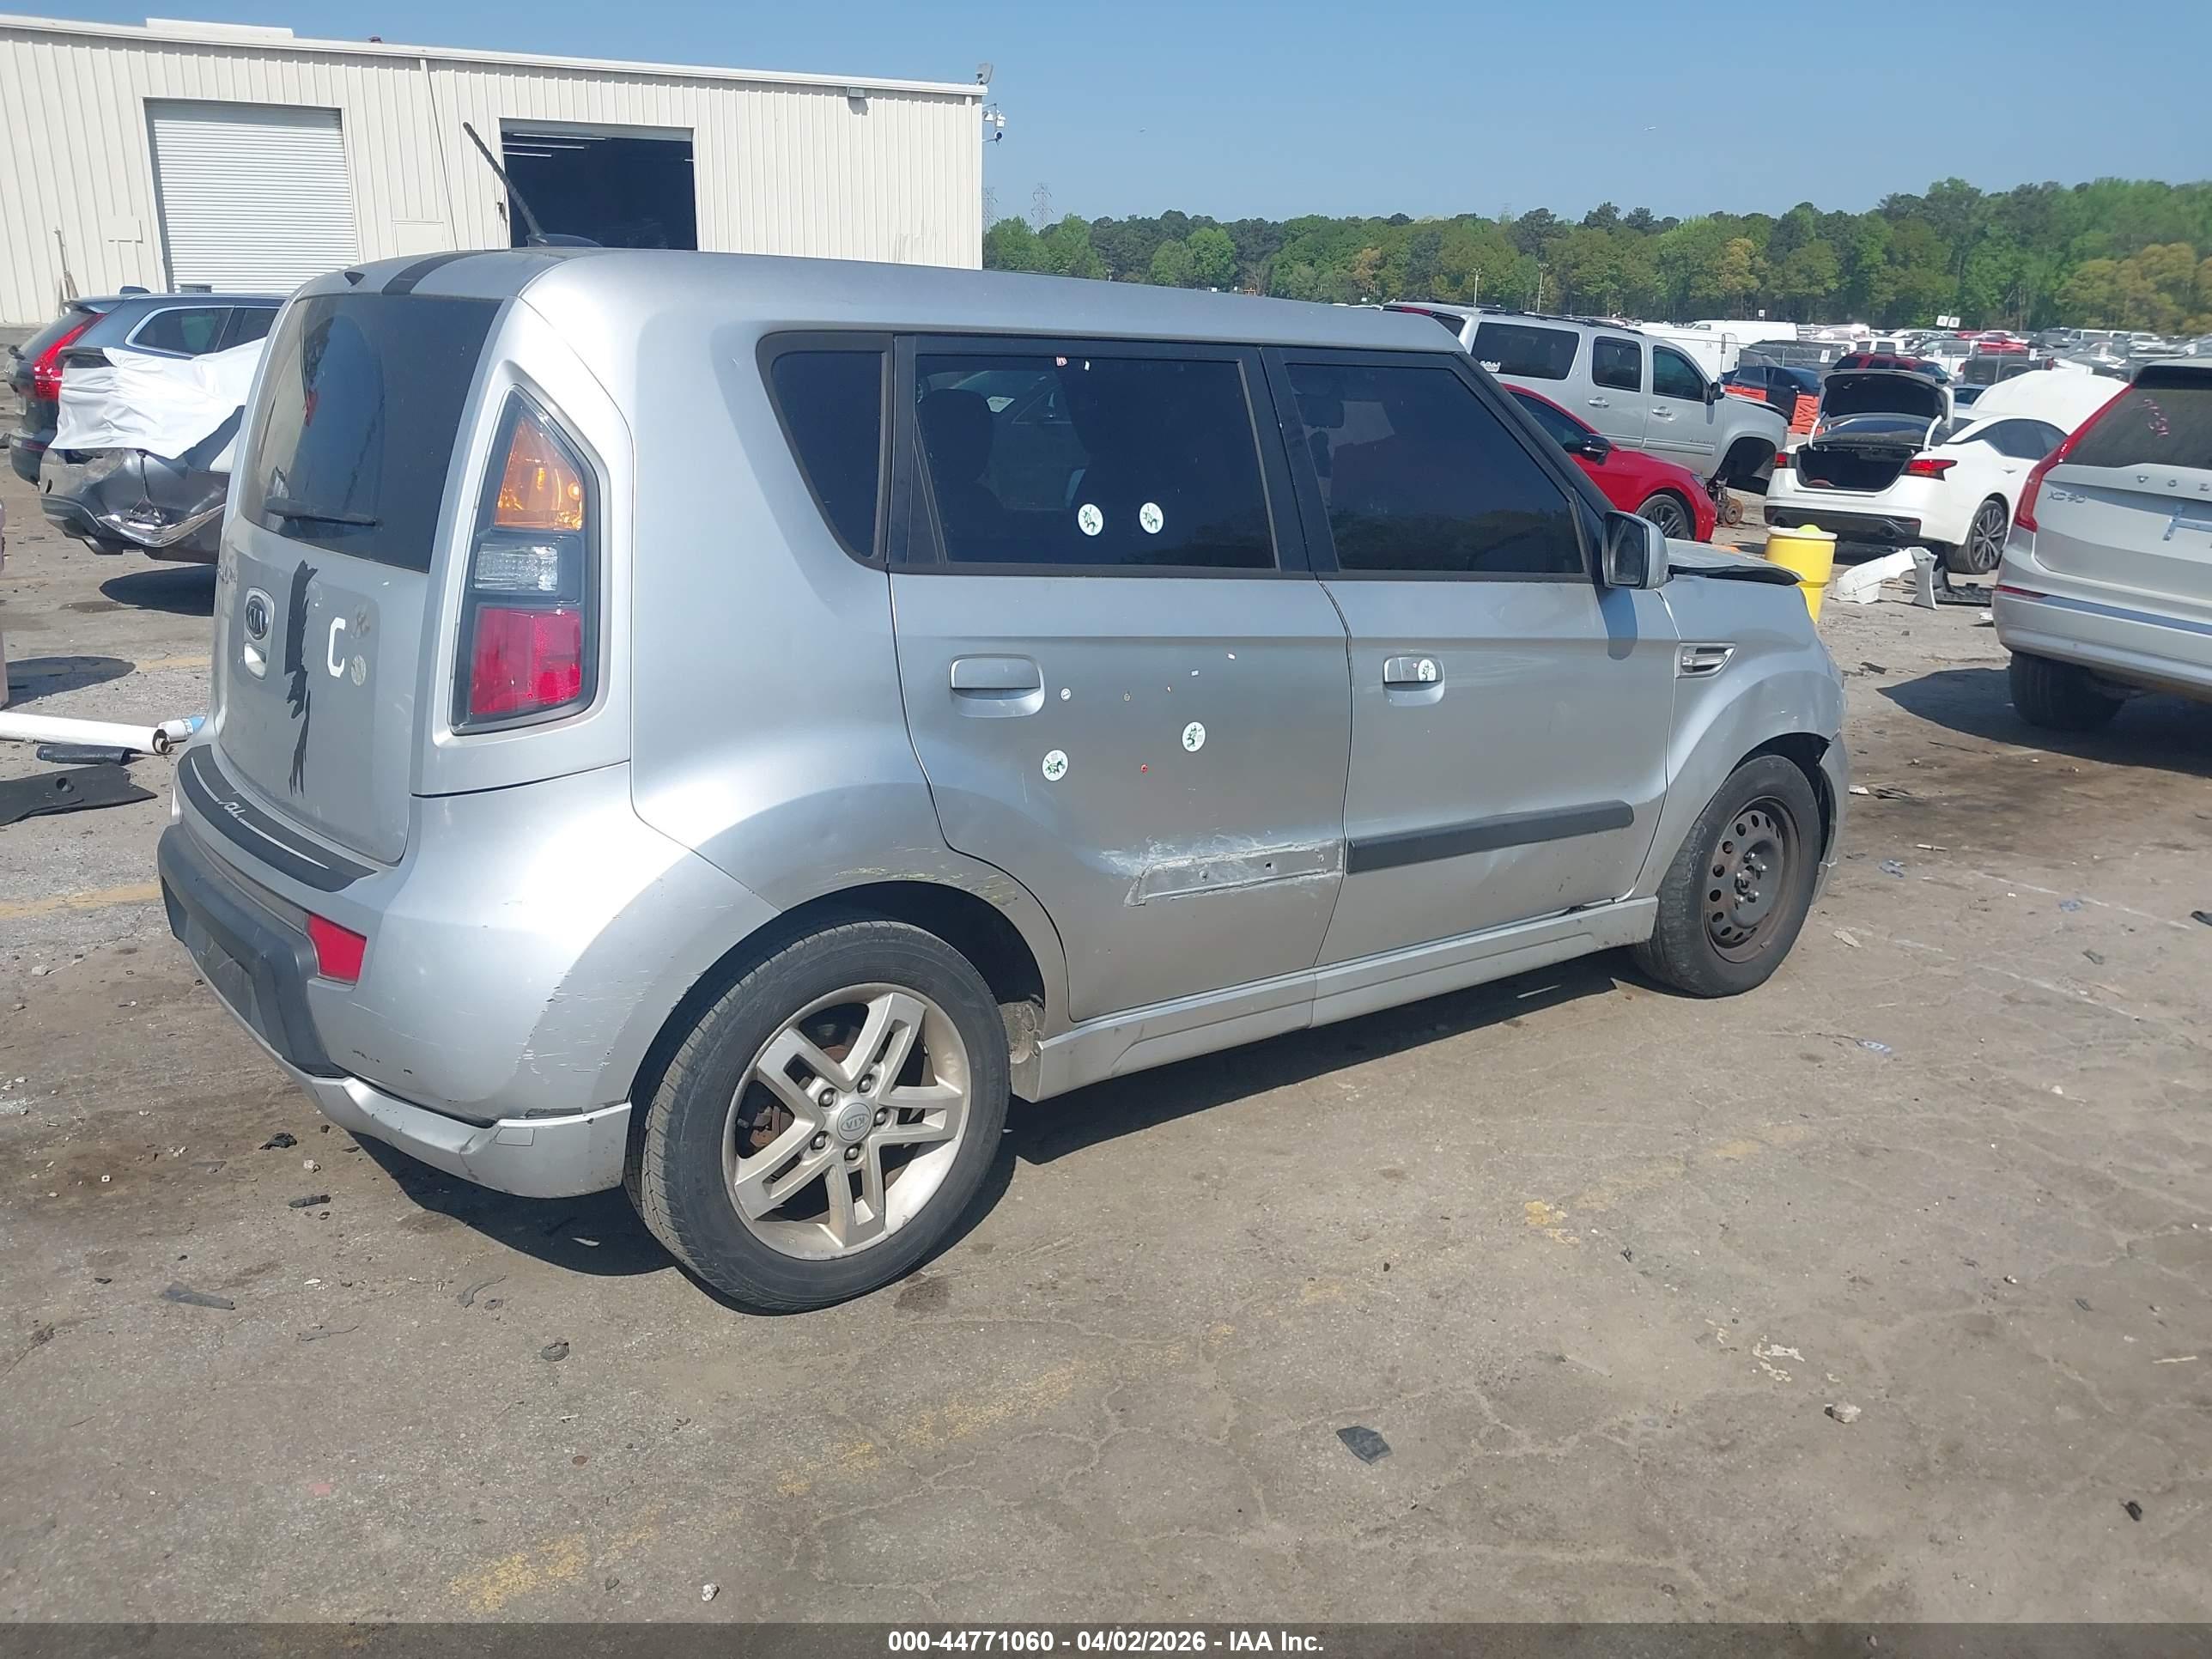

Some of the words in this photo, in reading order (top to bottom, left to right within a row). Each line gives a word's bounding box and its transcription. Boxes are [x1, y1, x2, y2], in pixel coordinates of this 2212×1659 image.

[2047, 490, 2088, 503] XC90
[327, 617, 346, 678] C
[846, 1116, 866, 1129] KIA
